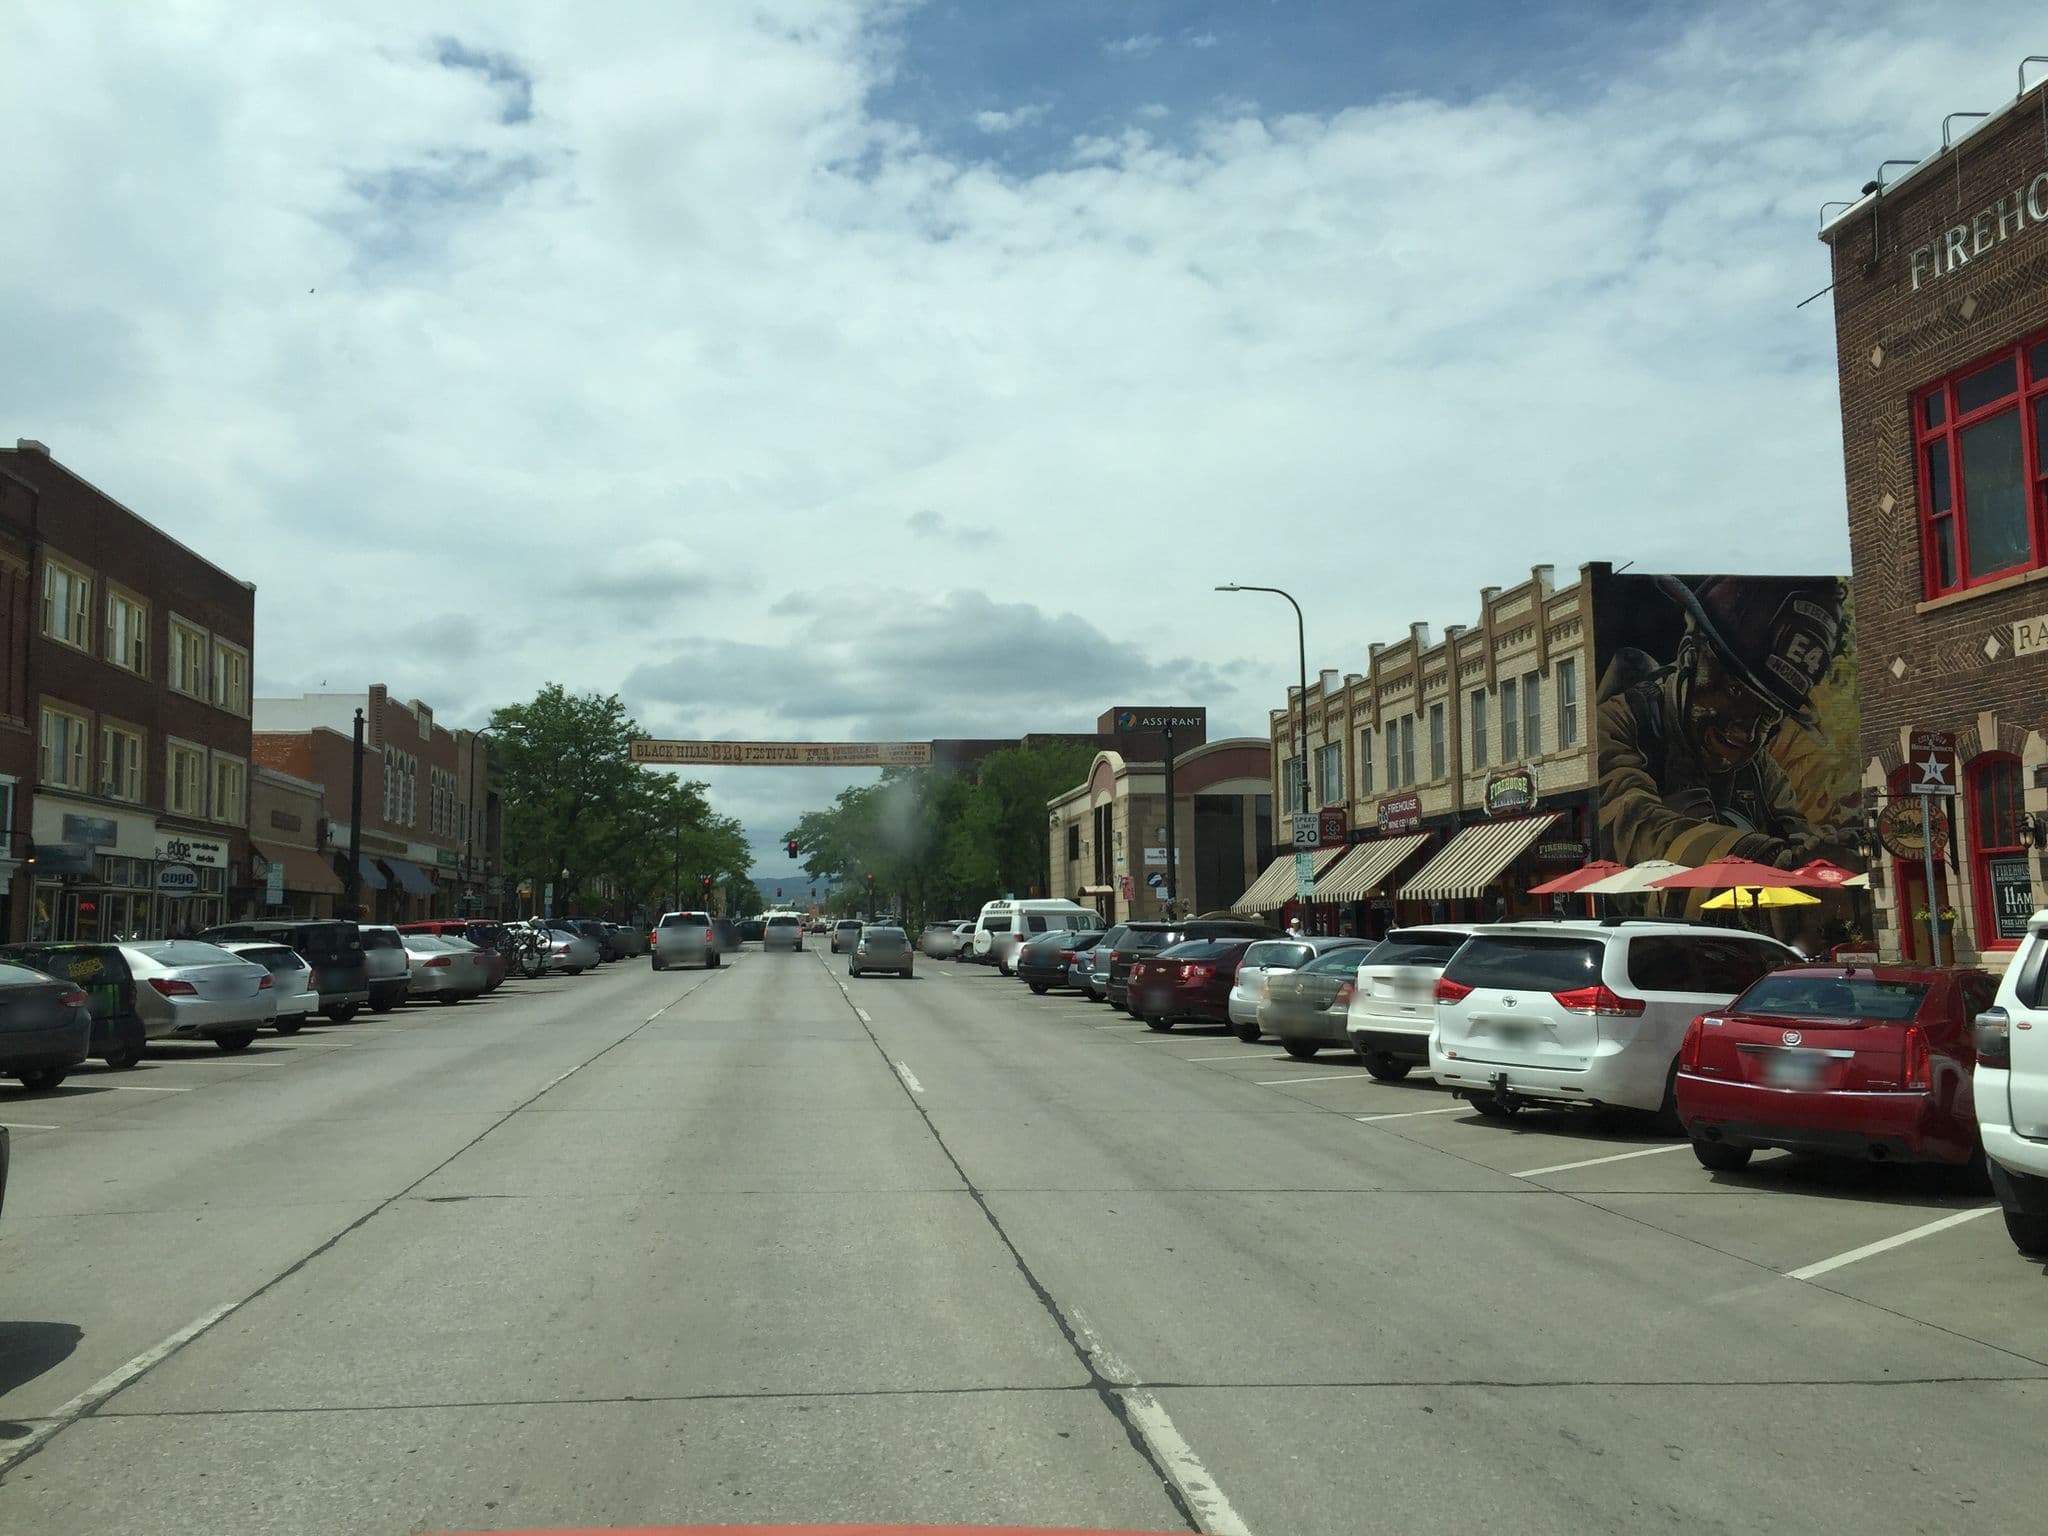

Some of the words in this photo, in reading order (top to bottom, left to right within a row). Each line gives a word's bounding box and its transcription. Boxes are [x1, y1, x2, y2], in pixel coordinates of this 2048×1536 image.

[1910, 172, 2048, 292] FIREHO
[637, 744, 673, 757] BLACK
[677, 745, 709, 759] HILLS
[711, 744, 742, 761] BBQ
[745, 747, 799, 760] FESTIVAL
[1928, 764, 1939, 774] 14
[1490, 776, 1528, 800] FIREHOUSE
[1388, 799, 1417, 813] FIREHOUSE
[1881, 799, 1943, 819] FIREHOSE
[1295, 830, 1318, 843] 20
[167, 837, 192, 858] edge
[1539, 843, 1585, 855] FIREHOUSE
[2001, 918, 2015, 926] FREE
[2015, 918, 2027, 926] LIVE
